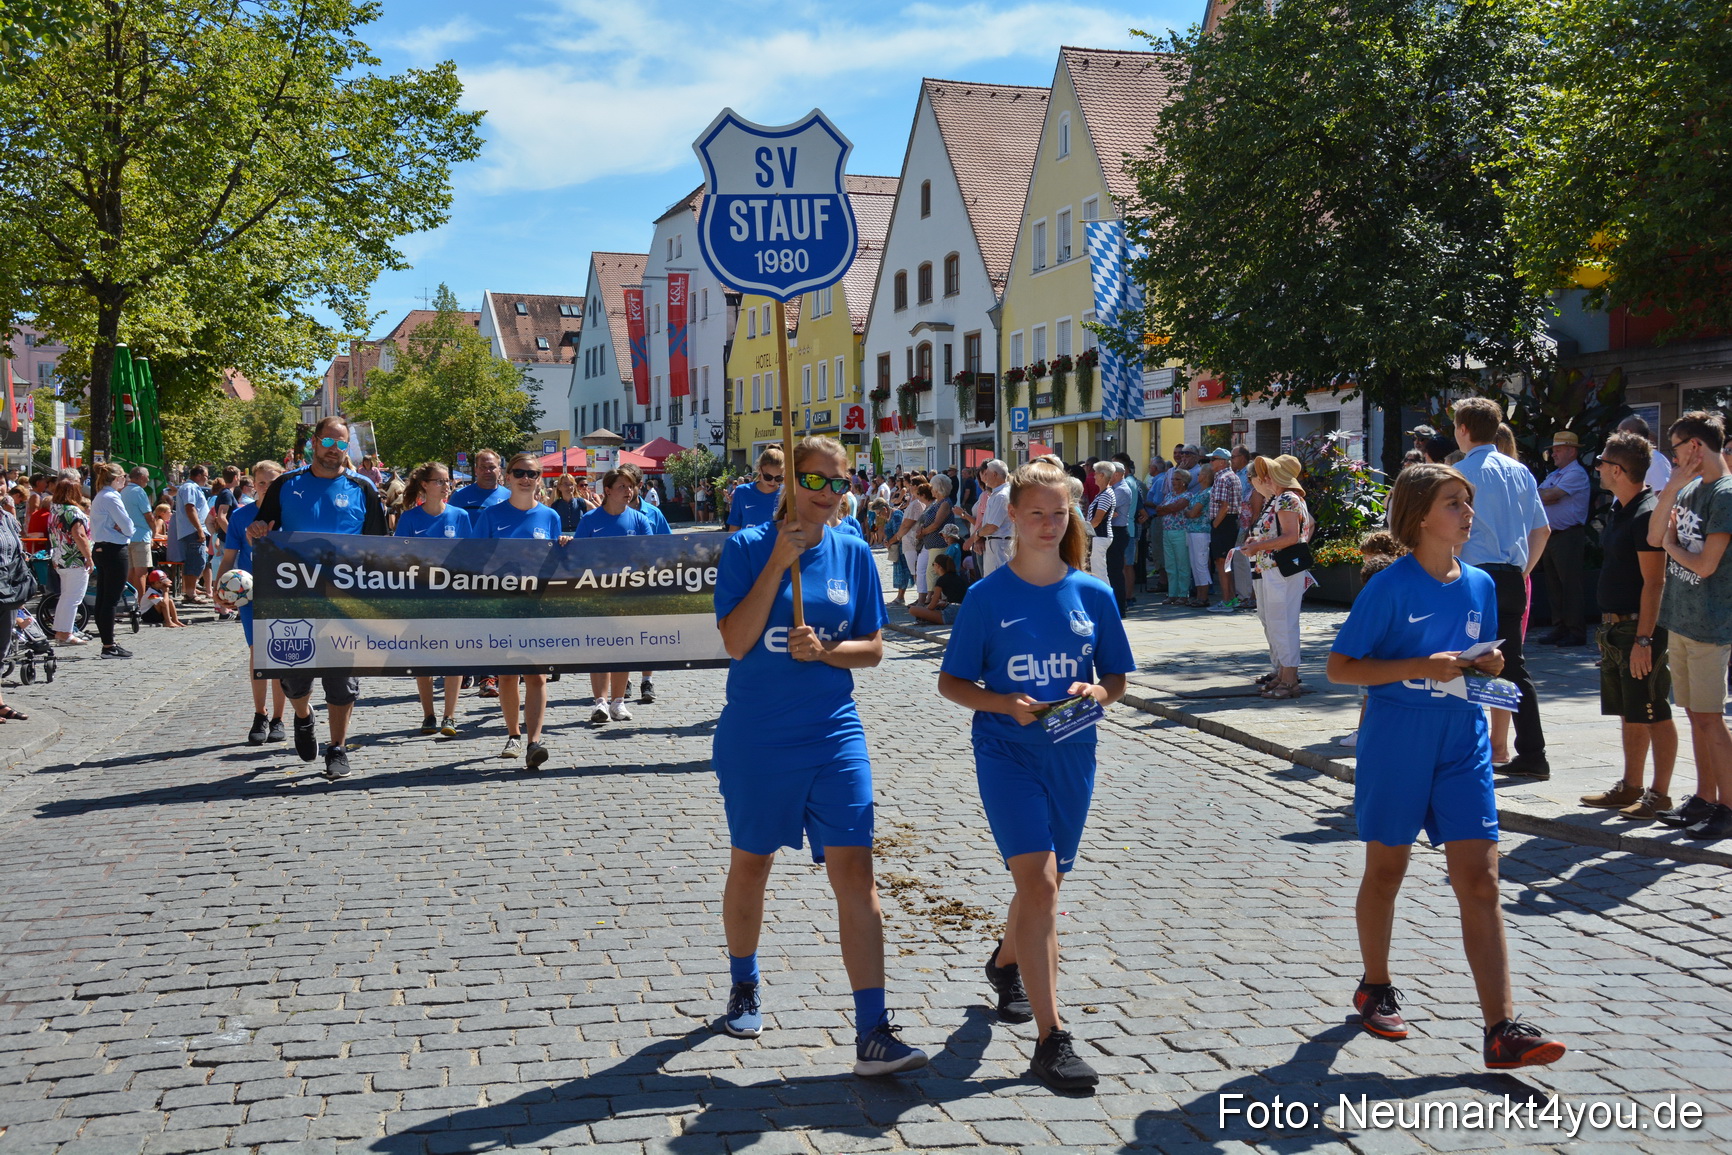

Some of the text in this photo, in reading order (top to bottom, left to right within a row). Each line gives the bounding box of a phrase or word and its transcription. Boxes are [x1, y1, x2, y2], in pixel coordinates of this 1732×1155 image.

[755, 146, 798, 189] SV
[729, 198, 831, 242] STAUF
[754, 248, 810, 274] 1980
[755, 353, 772, 369] HOTEL
[1015, 410, 1025, 430] P
[755, 427, 777, 438] Restaurant
[275, 563, 322, 590] SV
[333, 564, 420, 591] Stauf
[428, 567, 538, 592] Damen
[283, 625, 298, 637] SV
[330, 630, 682, 651] Wir bedanken uns bei unseren treuen Fans!
[273, 639, 309, 652] STAUF
[285, 652, 300, 661] 1980
[1007, 652, 1078, 686] Elyth
